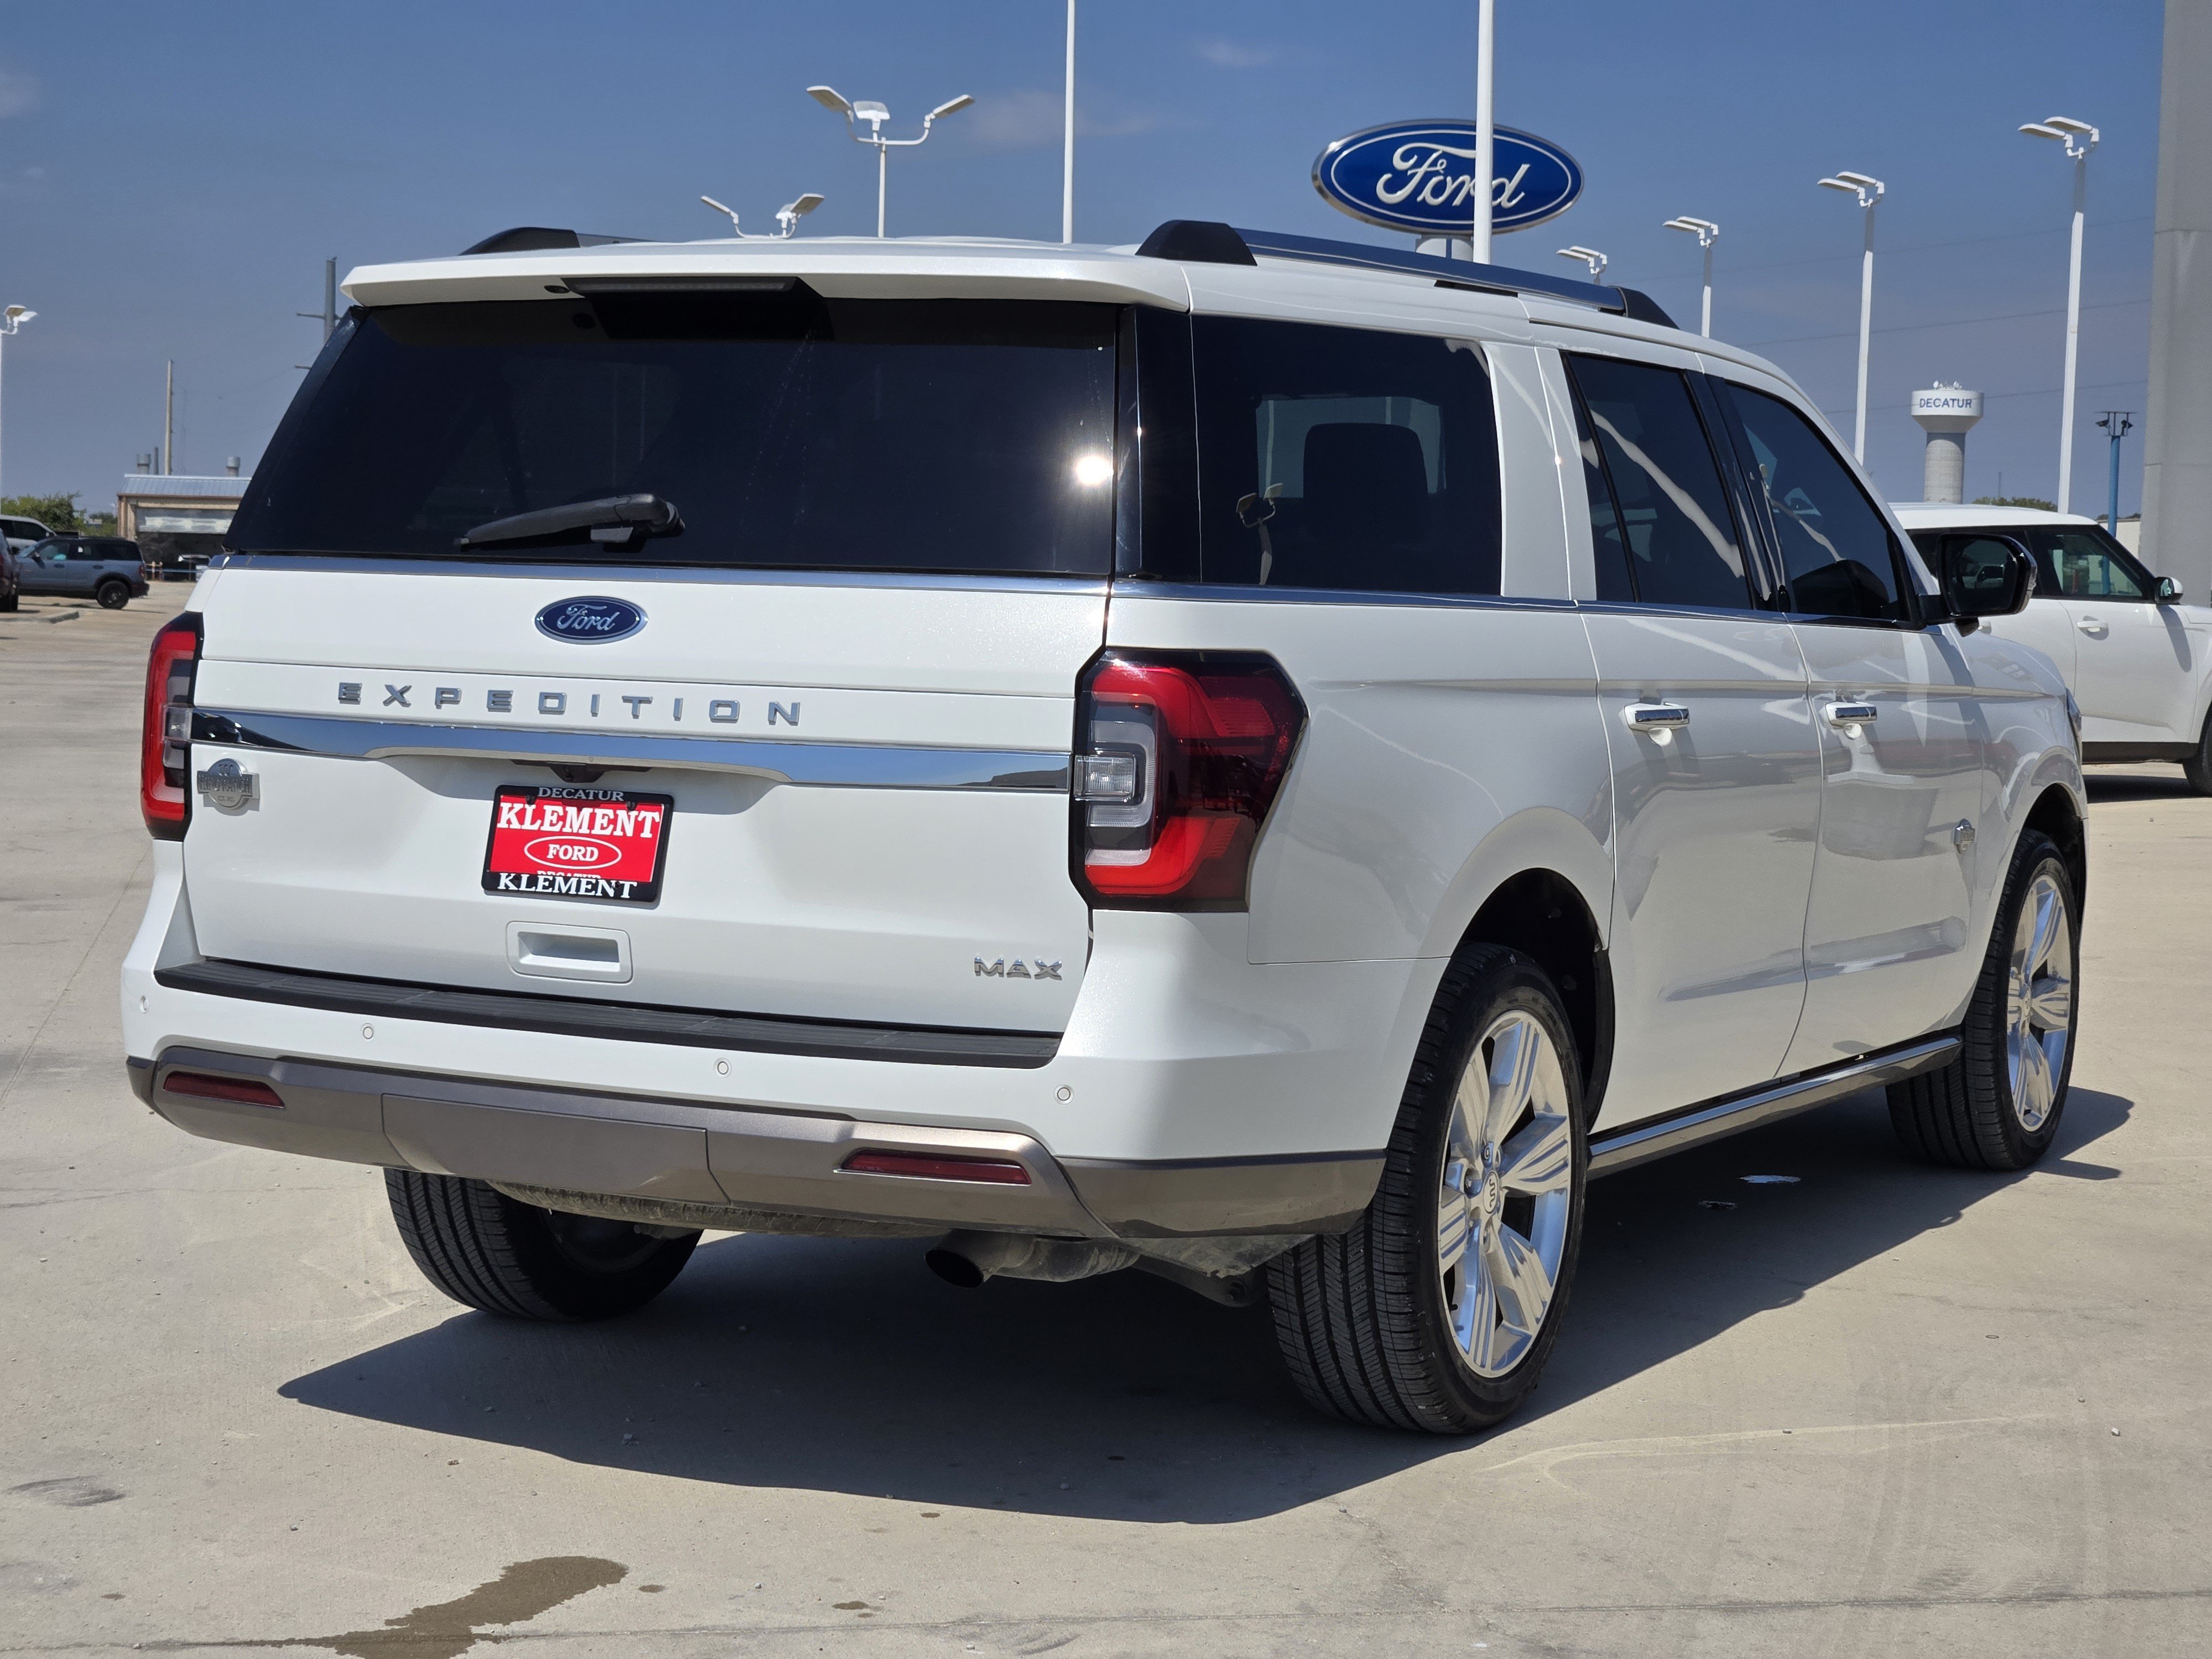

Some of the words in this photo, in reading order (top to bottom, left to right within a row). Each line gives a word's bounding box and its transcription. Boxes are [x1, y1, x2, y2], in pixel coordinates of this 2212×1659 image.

[1919, 398, 1973, 409] DECATUR
[556, 603, 620, 631] Ford
[338, 682, 801, 726] EXPEDITION
[538, 787, 624, 802] DECATUR
[497, 802, 660, 838] KLEMENT
[546, 843, 599, 862] FORD
[497, 873, 638, 899] KLEMENT
[974, 956, 1062, 980] MAX
